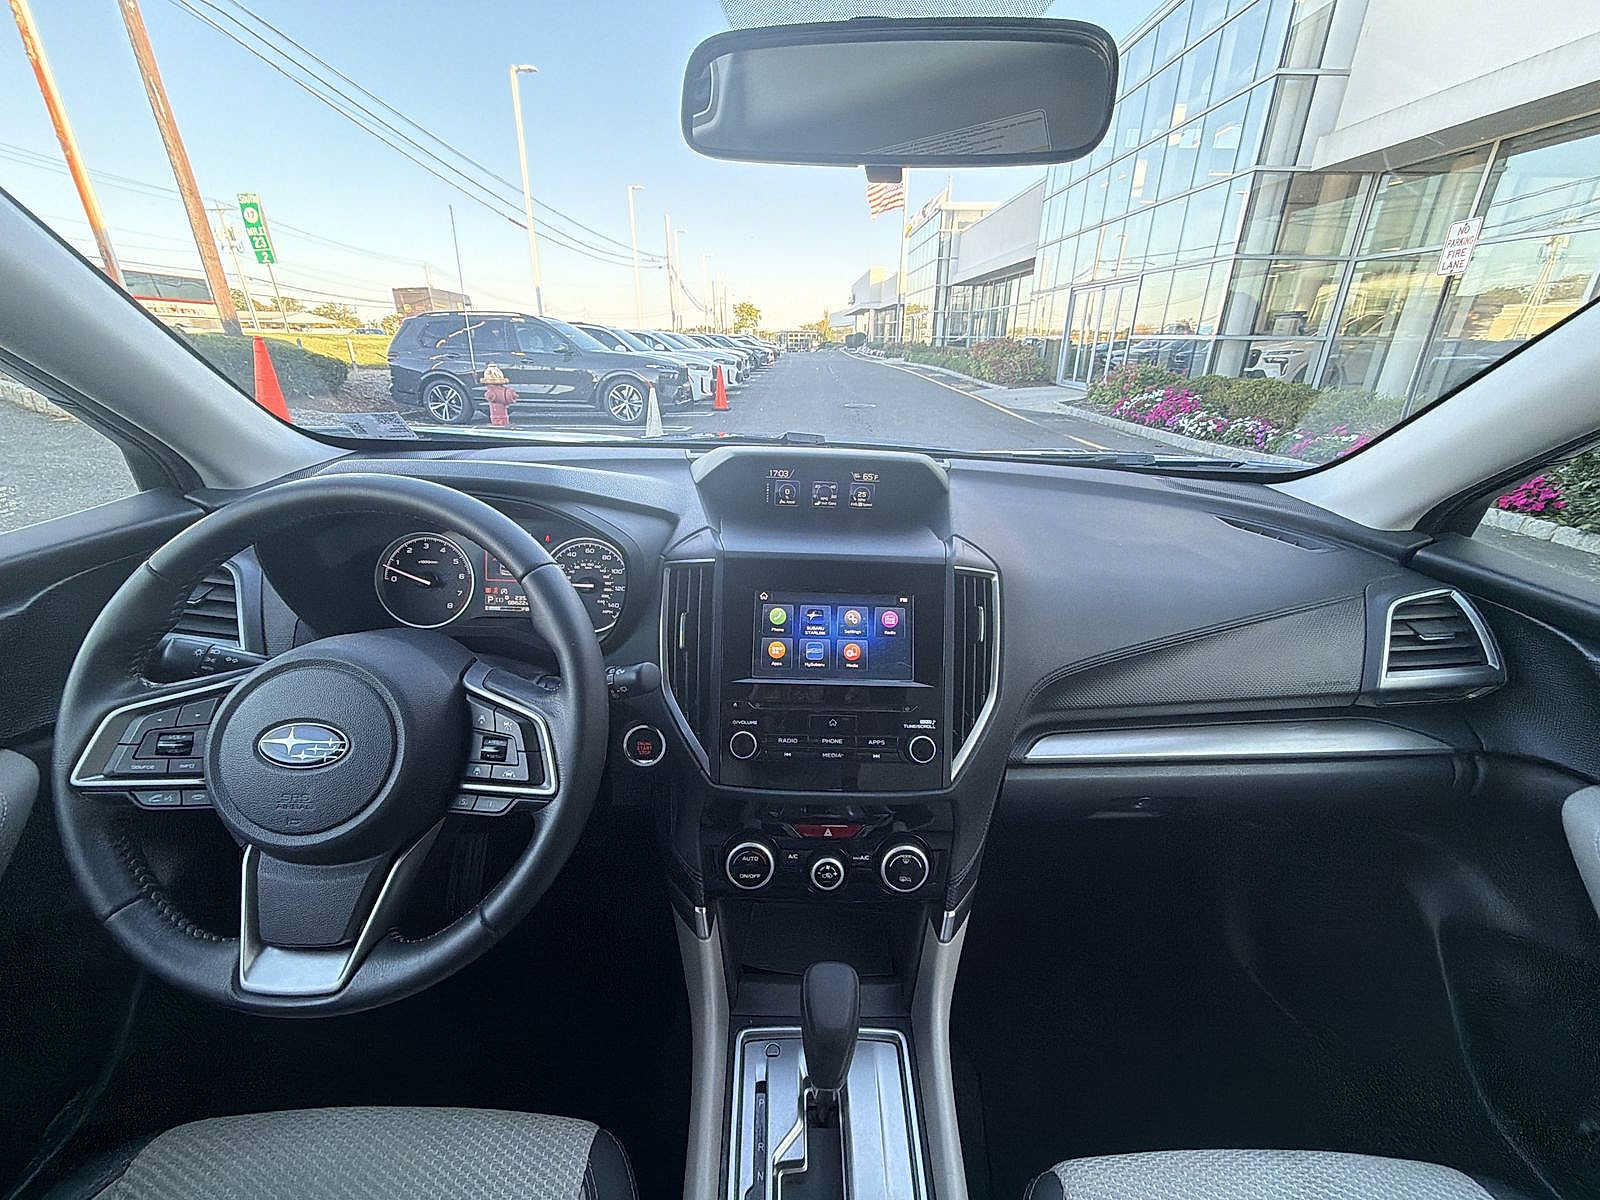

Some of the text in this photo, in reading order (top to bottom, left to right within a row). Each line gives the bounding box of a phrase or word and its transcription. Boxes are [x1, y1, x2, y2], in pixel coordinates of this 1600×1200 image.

[1457, 224, 1470, 236] NO
[253, 237, 267, 249] 23
[1447, 235, 1474, 247] PARKING
[1447, 247, 1467, 259] FIRE
[1442, 259, 1466, 271] LANE
[758, 1098, 765, 1107] P
[757, 1142, 765, 1152] R
[757, 1170, 764, 1181] N
